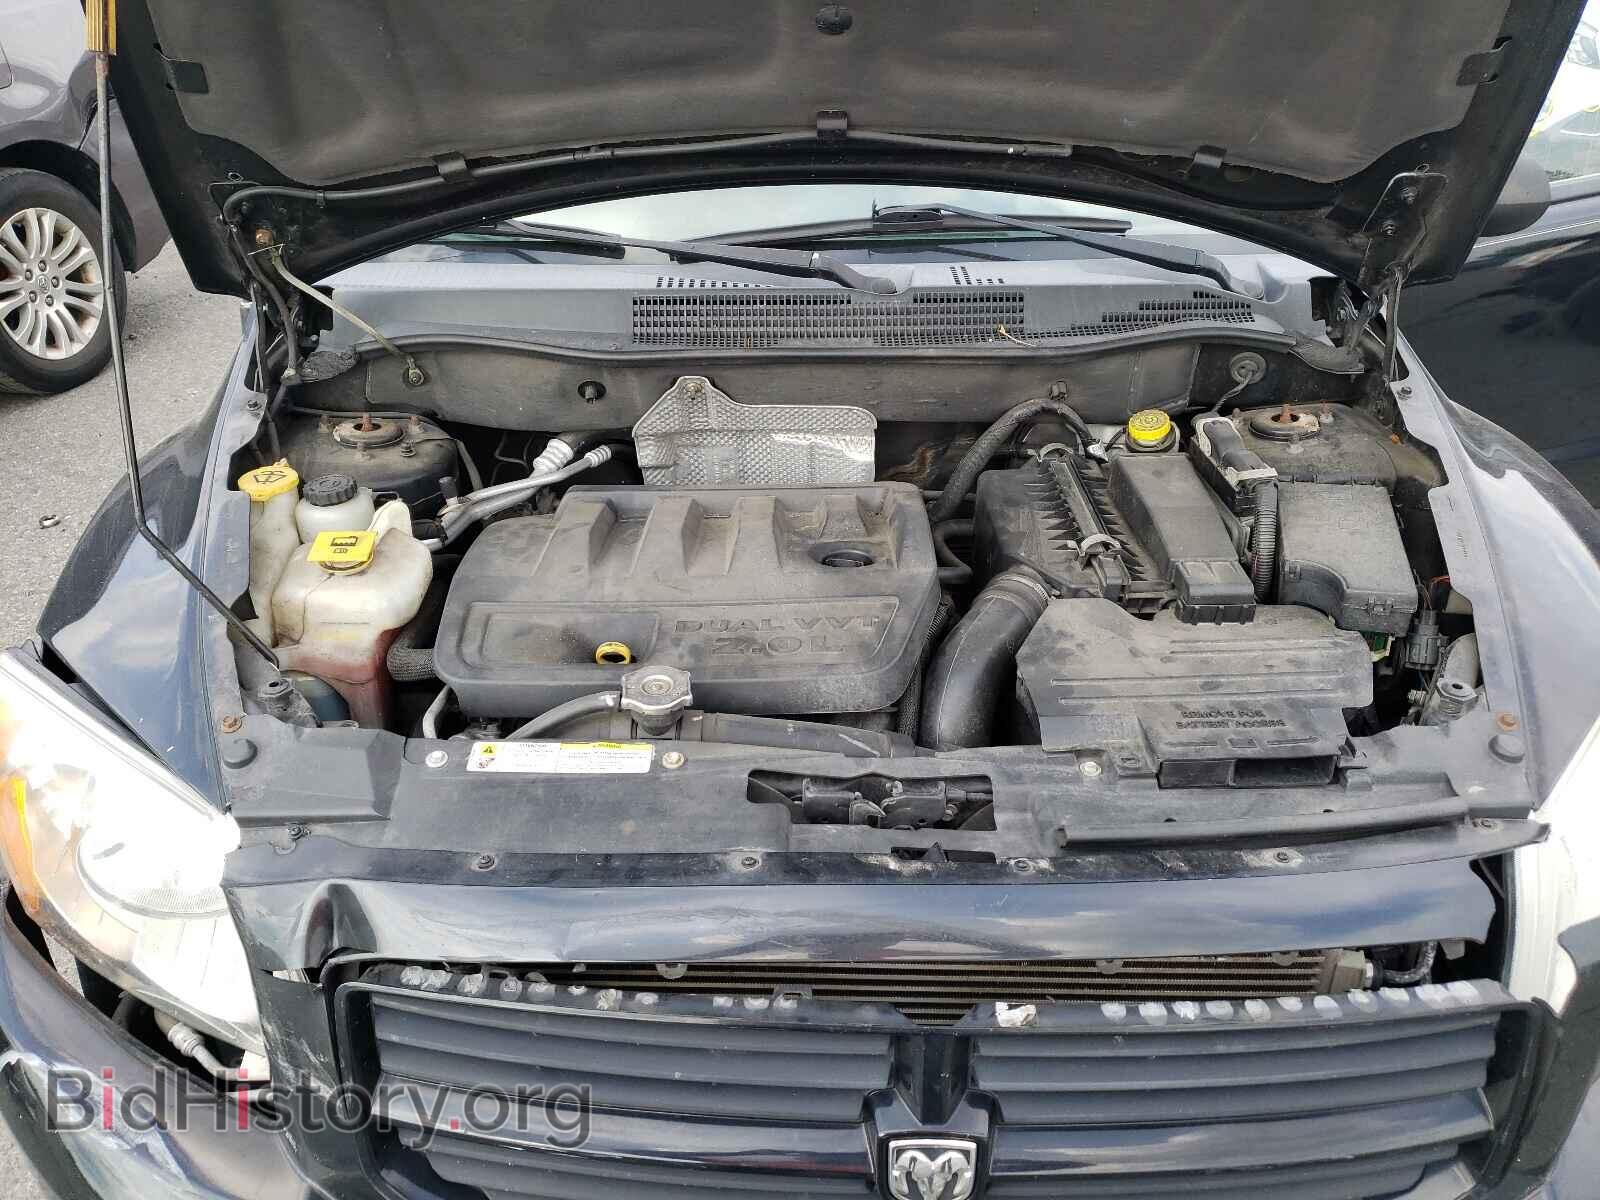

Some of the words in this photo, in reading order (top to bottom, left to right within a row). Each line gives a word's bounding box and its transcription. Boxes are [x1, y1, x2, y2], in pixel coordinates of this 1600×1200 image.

[674, 618, 786, 632] DUAL
[792, 616, 880, 630] VVT
[711, 636, 846, 655] 2.0L
